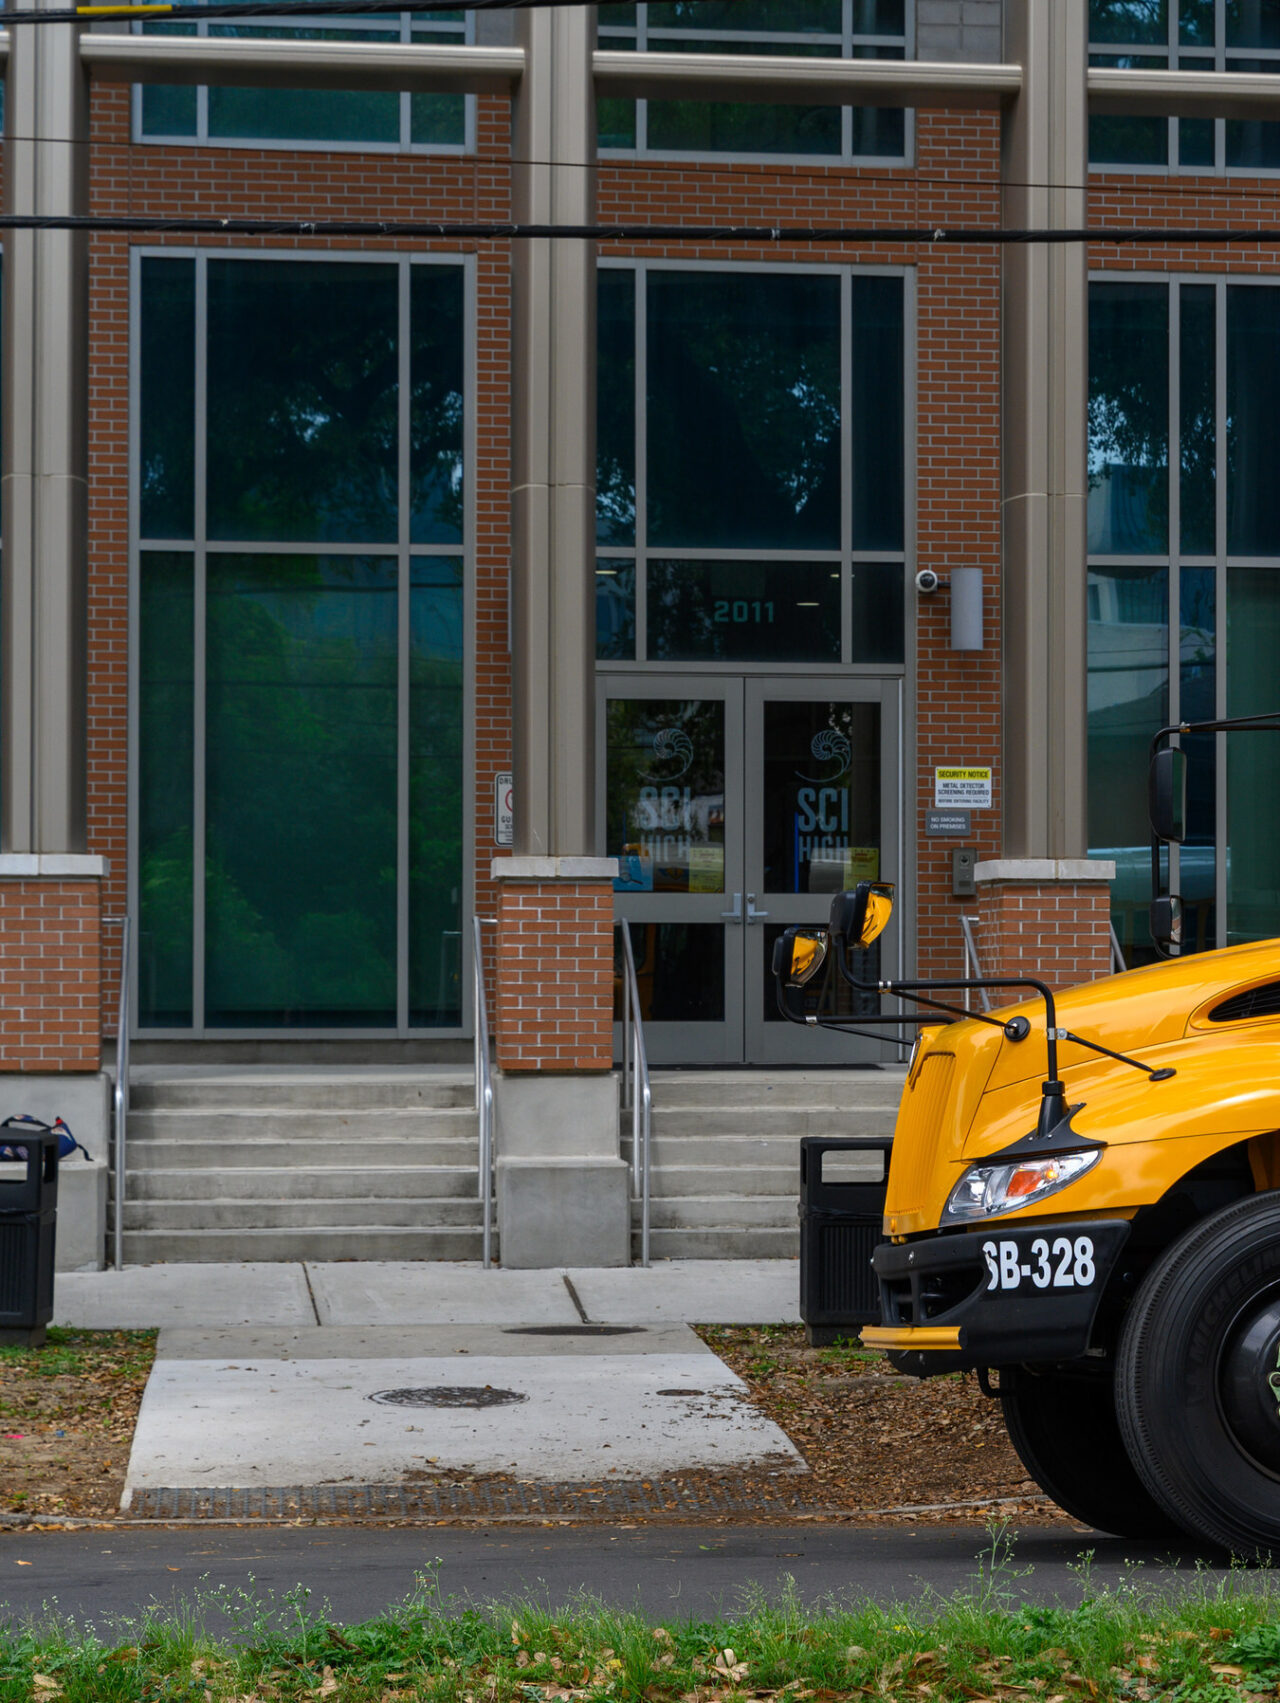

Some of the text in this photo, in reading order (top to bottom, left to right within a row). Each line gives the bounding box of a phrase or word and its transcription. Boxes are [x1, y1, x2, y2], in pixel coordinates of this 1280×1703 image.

[714, 600, 774, 623] 2011
[797, 787, 849, 832] SCI
[798, 835, 849, 863] HIGH
[982, 1236, 1096, 1291] SB-328
